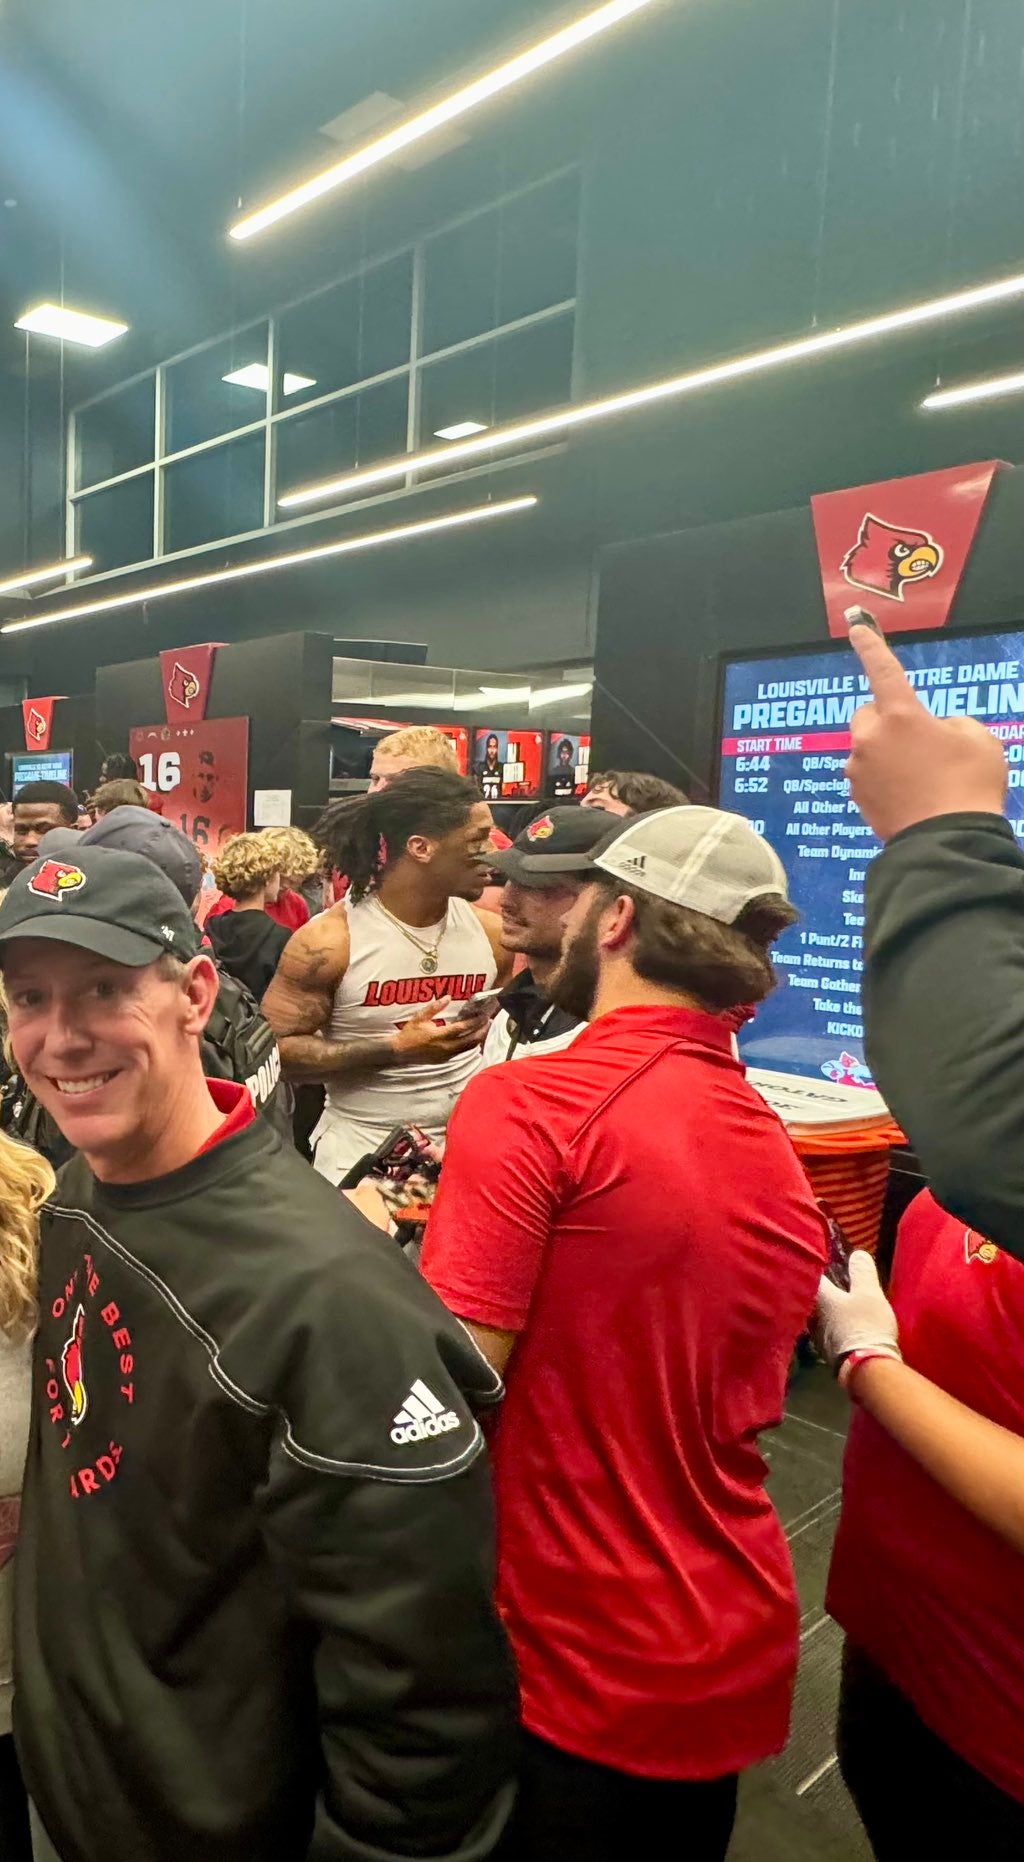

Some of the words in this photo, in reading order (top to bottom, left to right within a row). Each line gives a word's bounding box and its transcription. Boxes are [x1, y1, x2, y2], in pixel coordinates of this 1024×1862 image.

[758, 676, 854, 699] LOUISVILLE
[904, 667, 953, 687] OTRE
[957, 661, 1019, 684] DAME
[737, 739, 772, 753] START
[774, 737, 803, 751] TIME
[139, 752, 181, 792] 16
[735, 756, 771, 772] 6:44
[734, 777, 769, 793] 6:52
[793, 801, 809, 814] All
[812, 801, 845, 814] Other
[786, 823, 800, 836] All
[802, 823, 830, 836] Other
[798, 845, 828, 858] Team
[800, 932, 806, 944] 1
[771, 951, 801, 966] Team
[803, 953, 850, 970] Returns
[788, 973, 818, 988] Team
[813, 997, 841, 1014] Take
[101, 1301, 133, 1404] BEST
[390, 1411, 460, 1445] adidas
